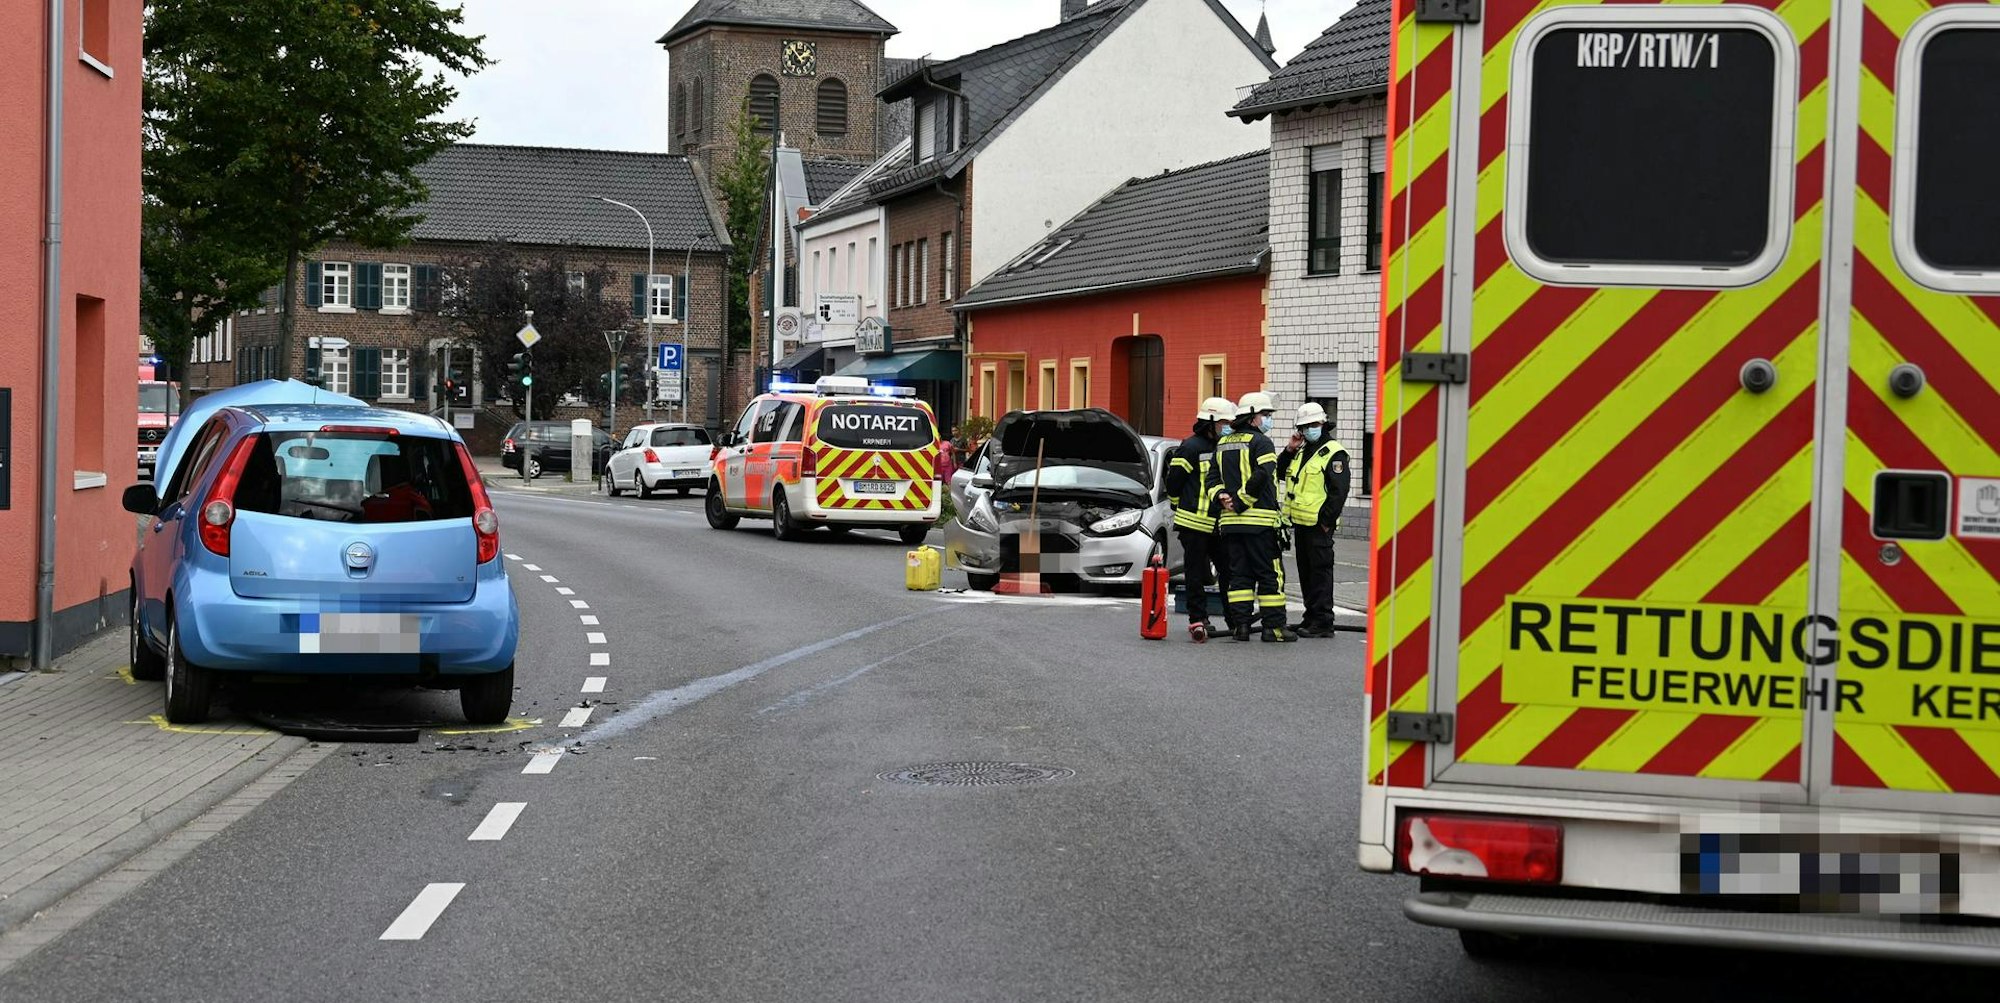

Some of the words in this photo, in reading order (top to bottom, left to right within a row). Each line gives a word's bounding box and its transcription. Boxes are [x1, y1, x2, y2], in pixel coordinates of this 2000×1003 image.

[1577, 32, 1719, 68] KRP/RTW/1
[664, 346, 677, 367] P
[831, 413, 919, 432] NOTARZT
[1509, 601, 2000, 675] RETTUNGSDIE
[1571, 665, 1865, 714] FEUERWEHR
[1912, 683, 2000, 721] KER
